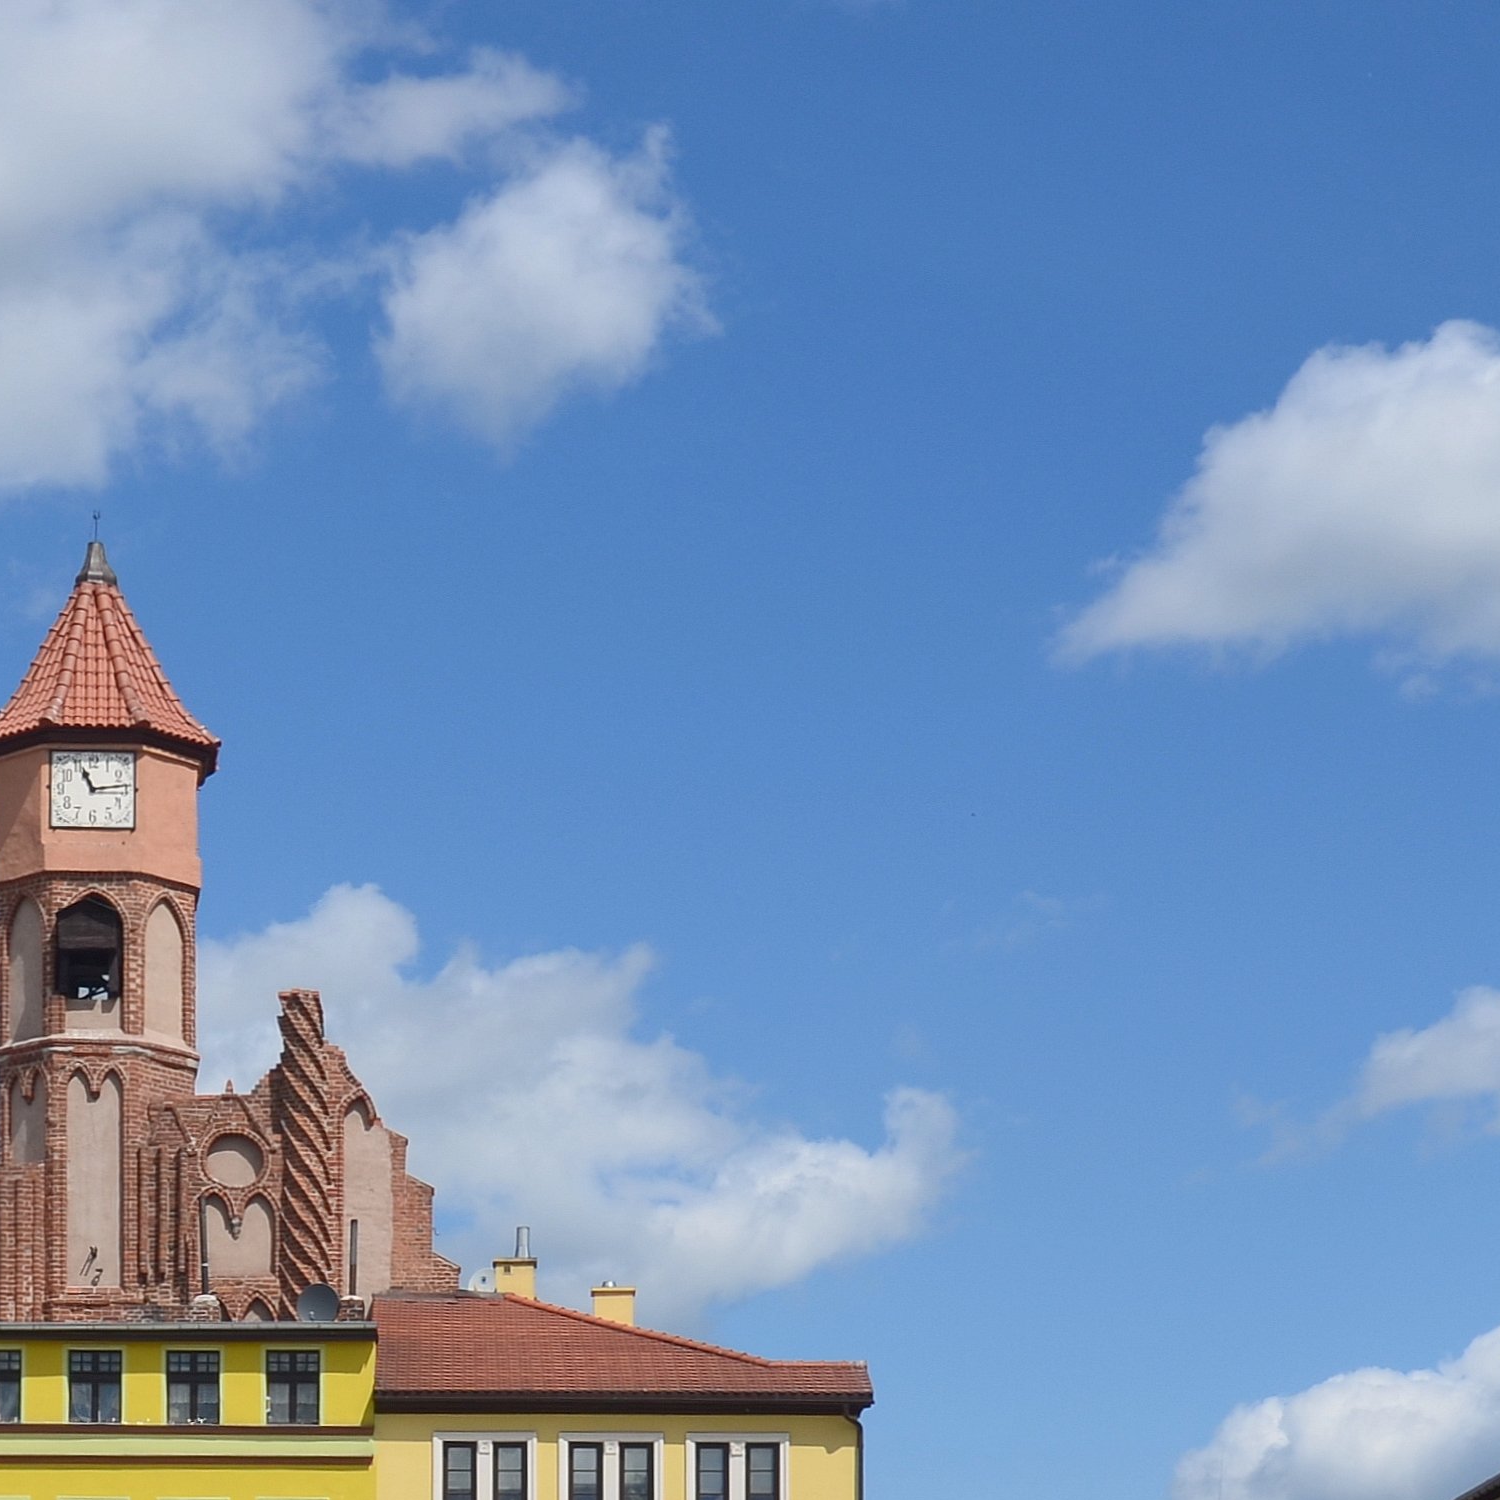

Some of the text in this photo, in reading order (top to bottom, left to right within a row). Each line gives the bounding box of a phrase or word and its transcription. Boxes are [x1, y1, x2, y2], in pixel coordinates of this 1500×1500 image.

[88, 757, 99, 769] 12
[62, 768, 73, 782] 10
[56, 782, 65, 795] 9
[63, 795, 71, 809] 8
[114, 797, 121, 809] 4
[73, 806, 82, 819] 7
[88, 809, 97, 823] 6
[104, 806, 112, 820] 5
